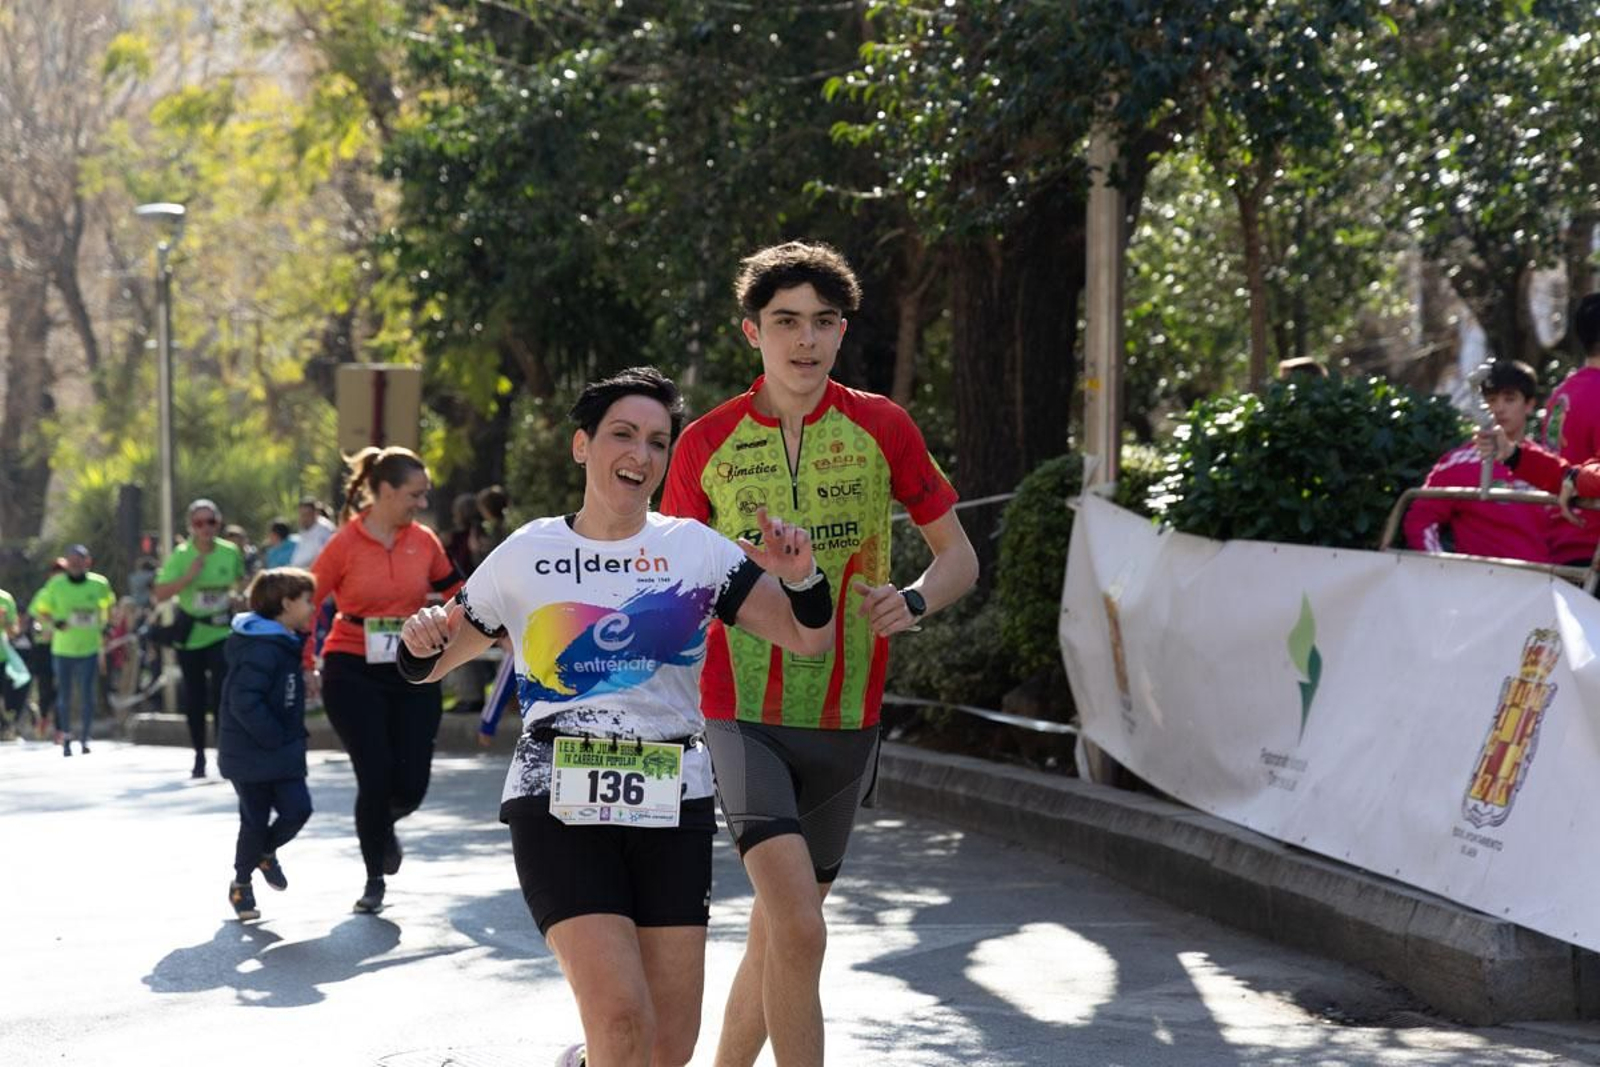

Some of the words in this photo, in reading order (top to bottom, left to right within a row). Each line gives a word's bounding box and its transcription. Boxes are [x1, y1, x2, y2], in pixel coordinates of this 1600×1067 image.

[831, 483, 862, 497] DUE
[828, 538, 860, 550] Moto
[535, 548, 668, 583] calderón
[574, 655, 656, 672] entrénate
[606, 755, 637, 767] POPULAR
[588, 770, 645, 805] 136
